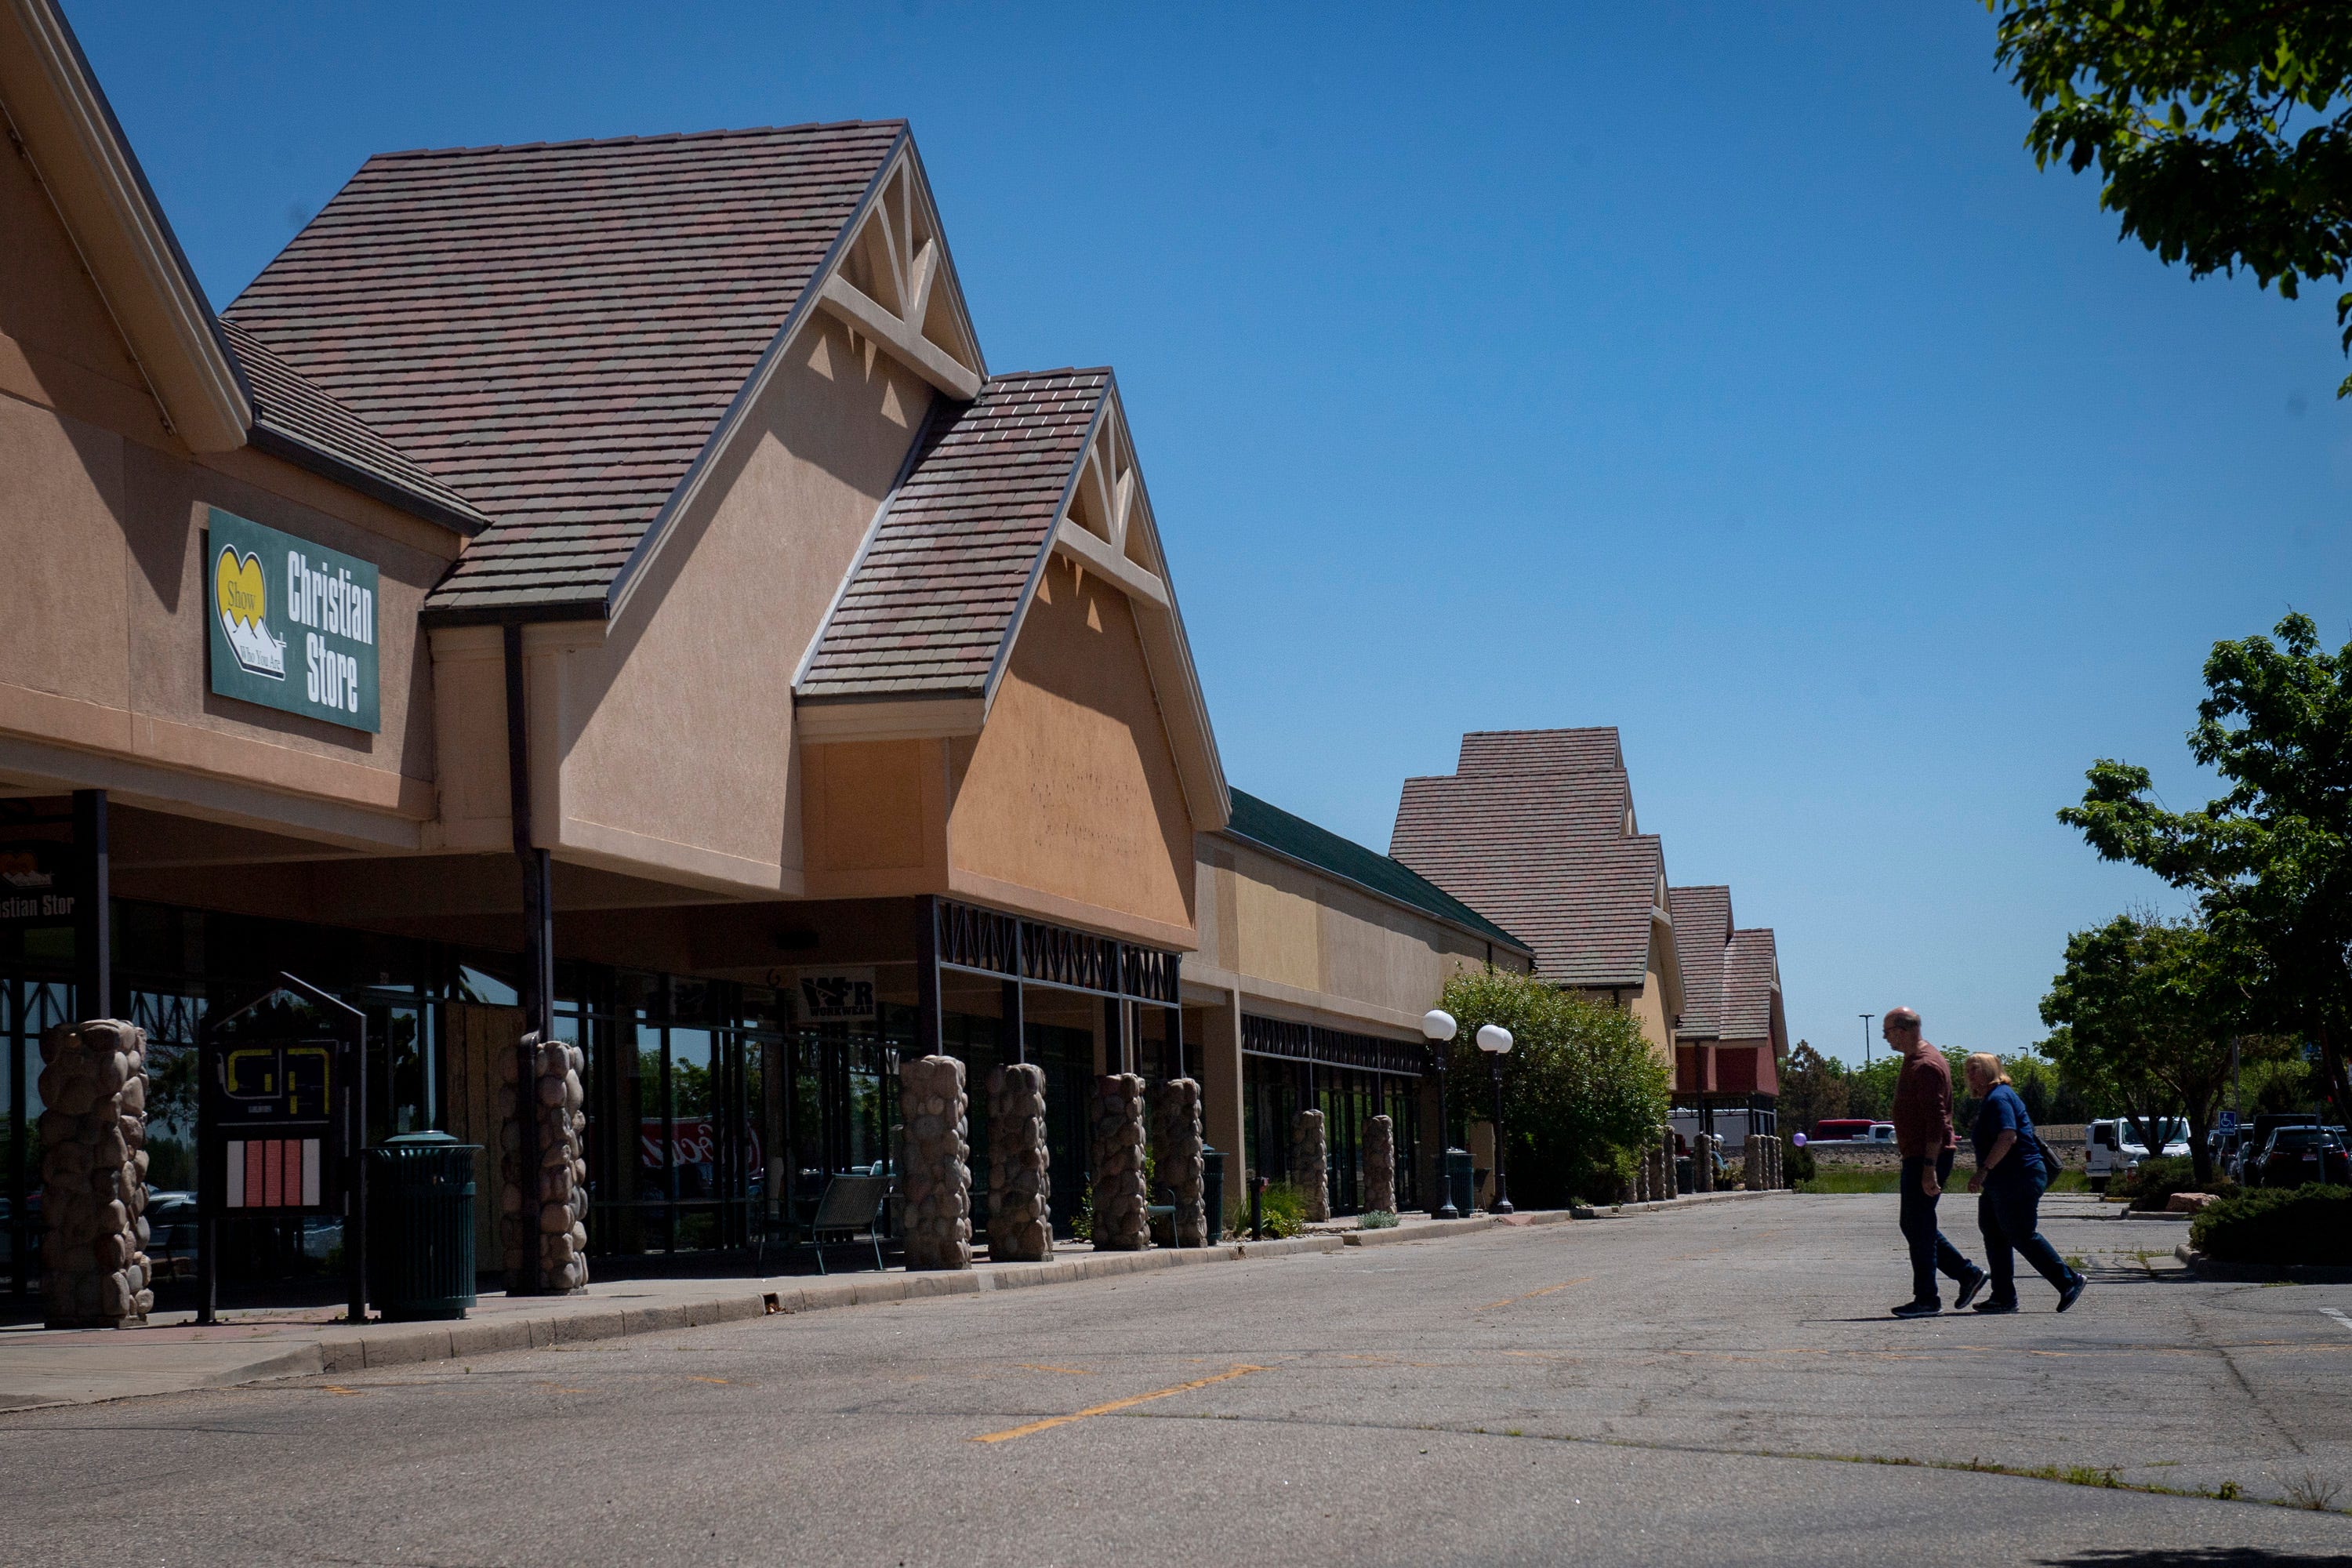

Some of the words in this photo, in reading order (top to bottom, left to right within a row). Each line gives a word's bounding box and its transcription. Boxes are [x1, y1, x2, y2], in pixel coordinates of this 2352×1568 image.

[227, 580, 256, 611] Show
[288, 550, 372, 645] Christian
[240, 645, 255, 664] Who
[256, 649, 269, 666] You
[269, 653, 281, 671] Are
[306, 632, 358, 713] Store
[42, 894, 76, 916] Stor
[810, 1005, 873, 1017] WORKWEAR
